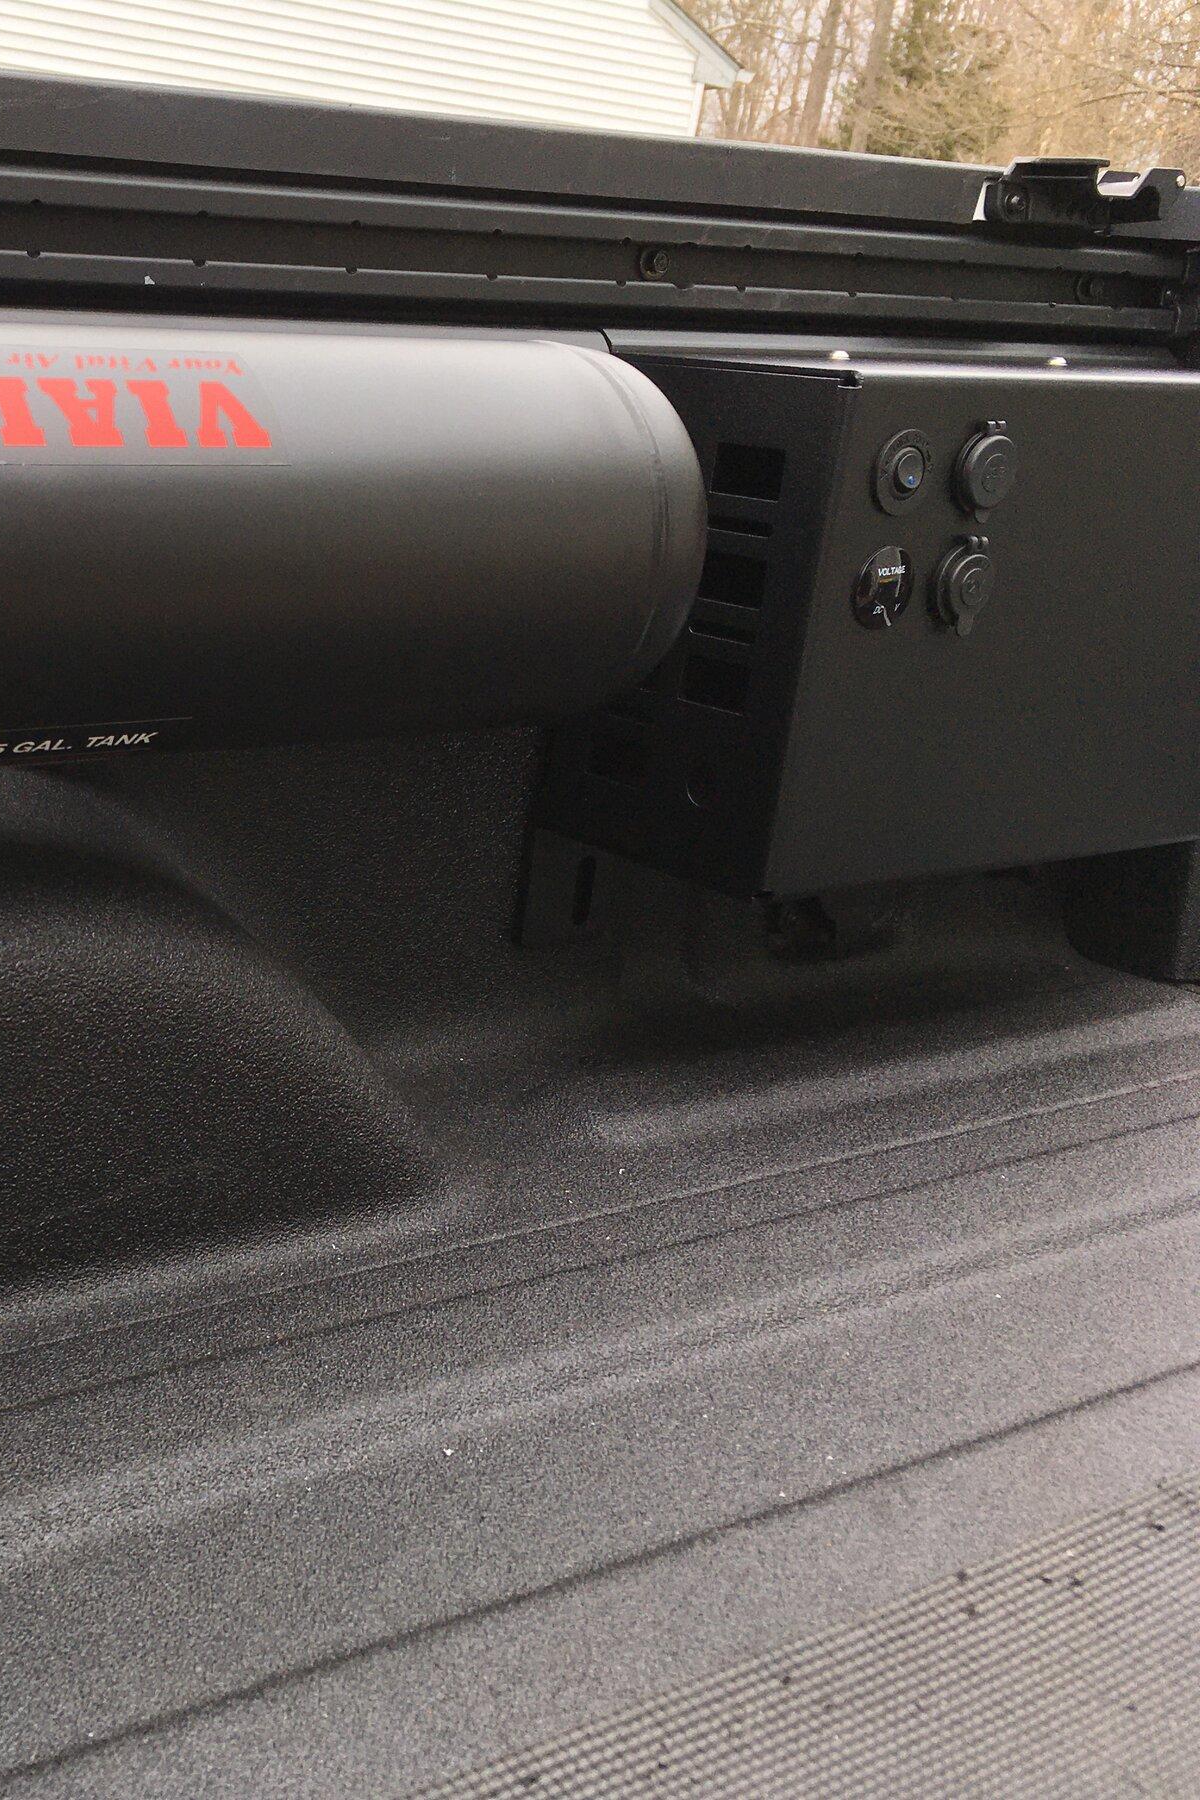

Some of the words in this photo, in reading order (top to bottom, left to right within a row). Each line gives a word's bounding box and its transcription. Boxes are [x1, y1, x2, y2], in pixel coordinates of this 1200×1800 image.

[6, 352, 61, 370] Air
[75, 354, 158, 373] Vital
[167, 356, 245, 376] Your
[877, 565, 906, 577] VOLTAGE
[11, 739, 72, 754] GAL.
[86, 731, 158, 749] TANK
